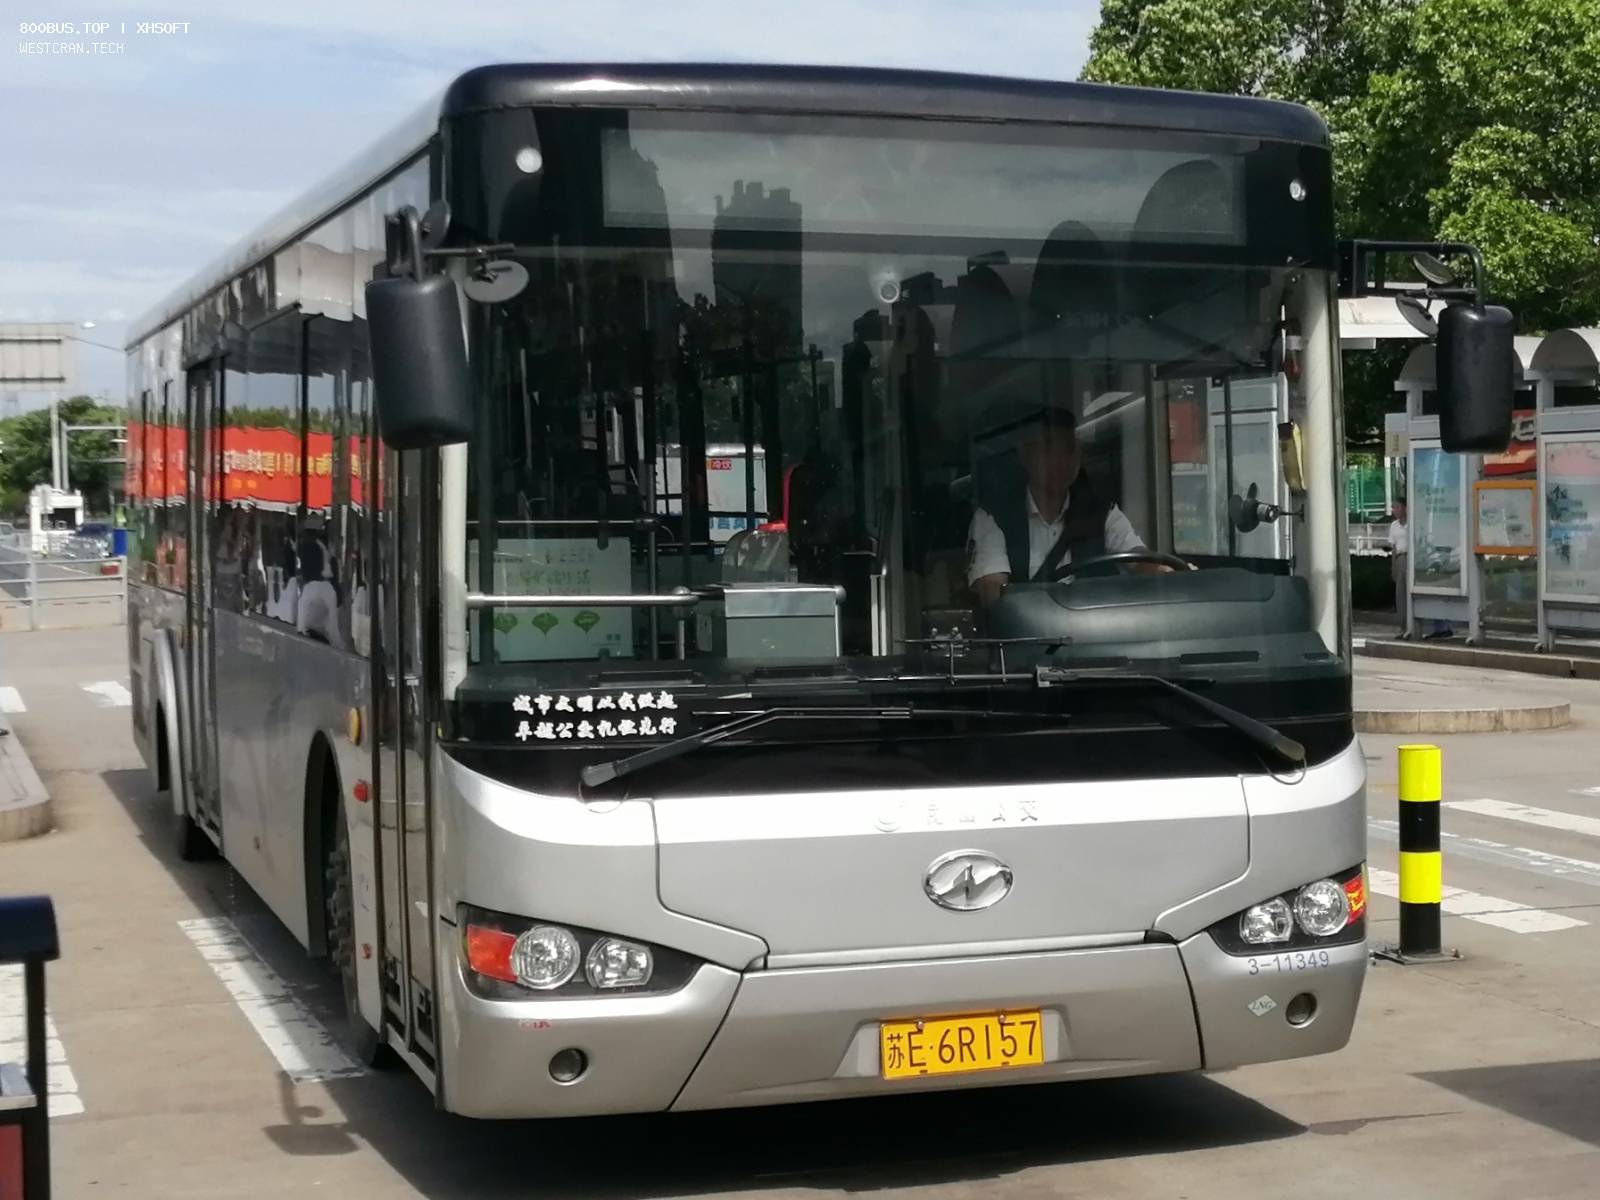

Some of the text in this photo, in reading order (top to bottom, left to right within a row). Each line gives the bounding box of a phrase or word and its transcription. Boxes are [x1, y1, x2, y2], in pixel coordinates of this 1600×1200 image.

[512, 690, 678, 715] 城市文明从我做起
[1247, 951, 1330, 975] 3-11349
